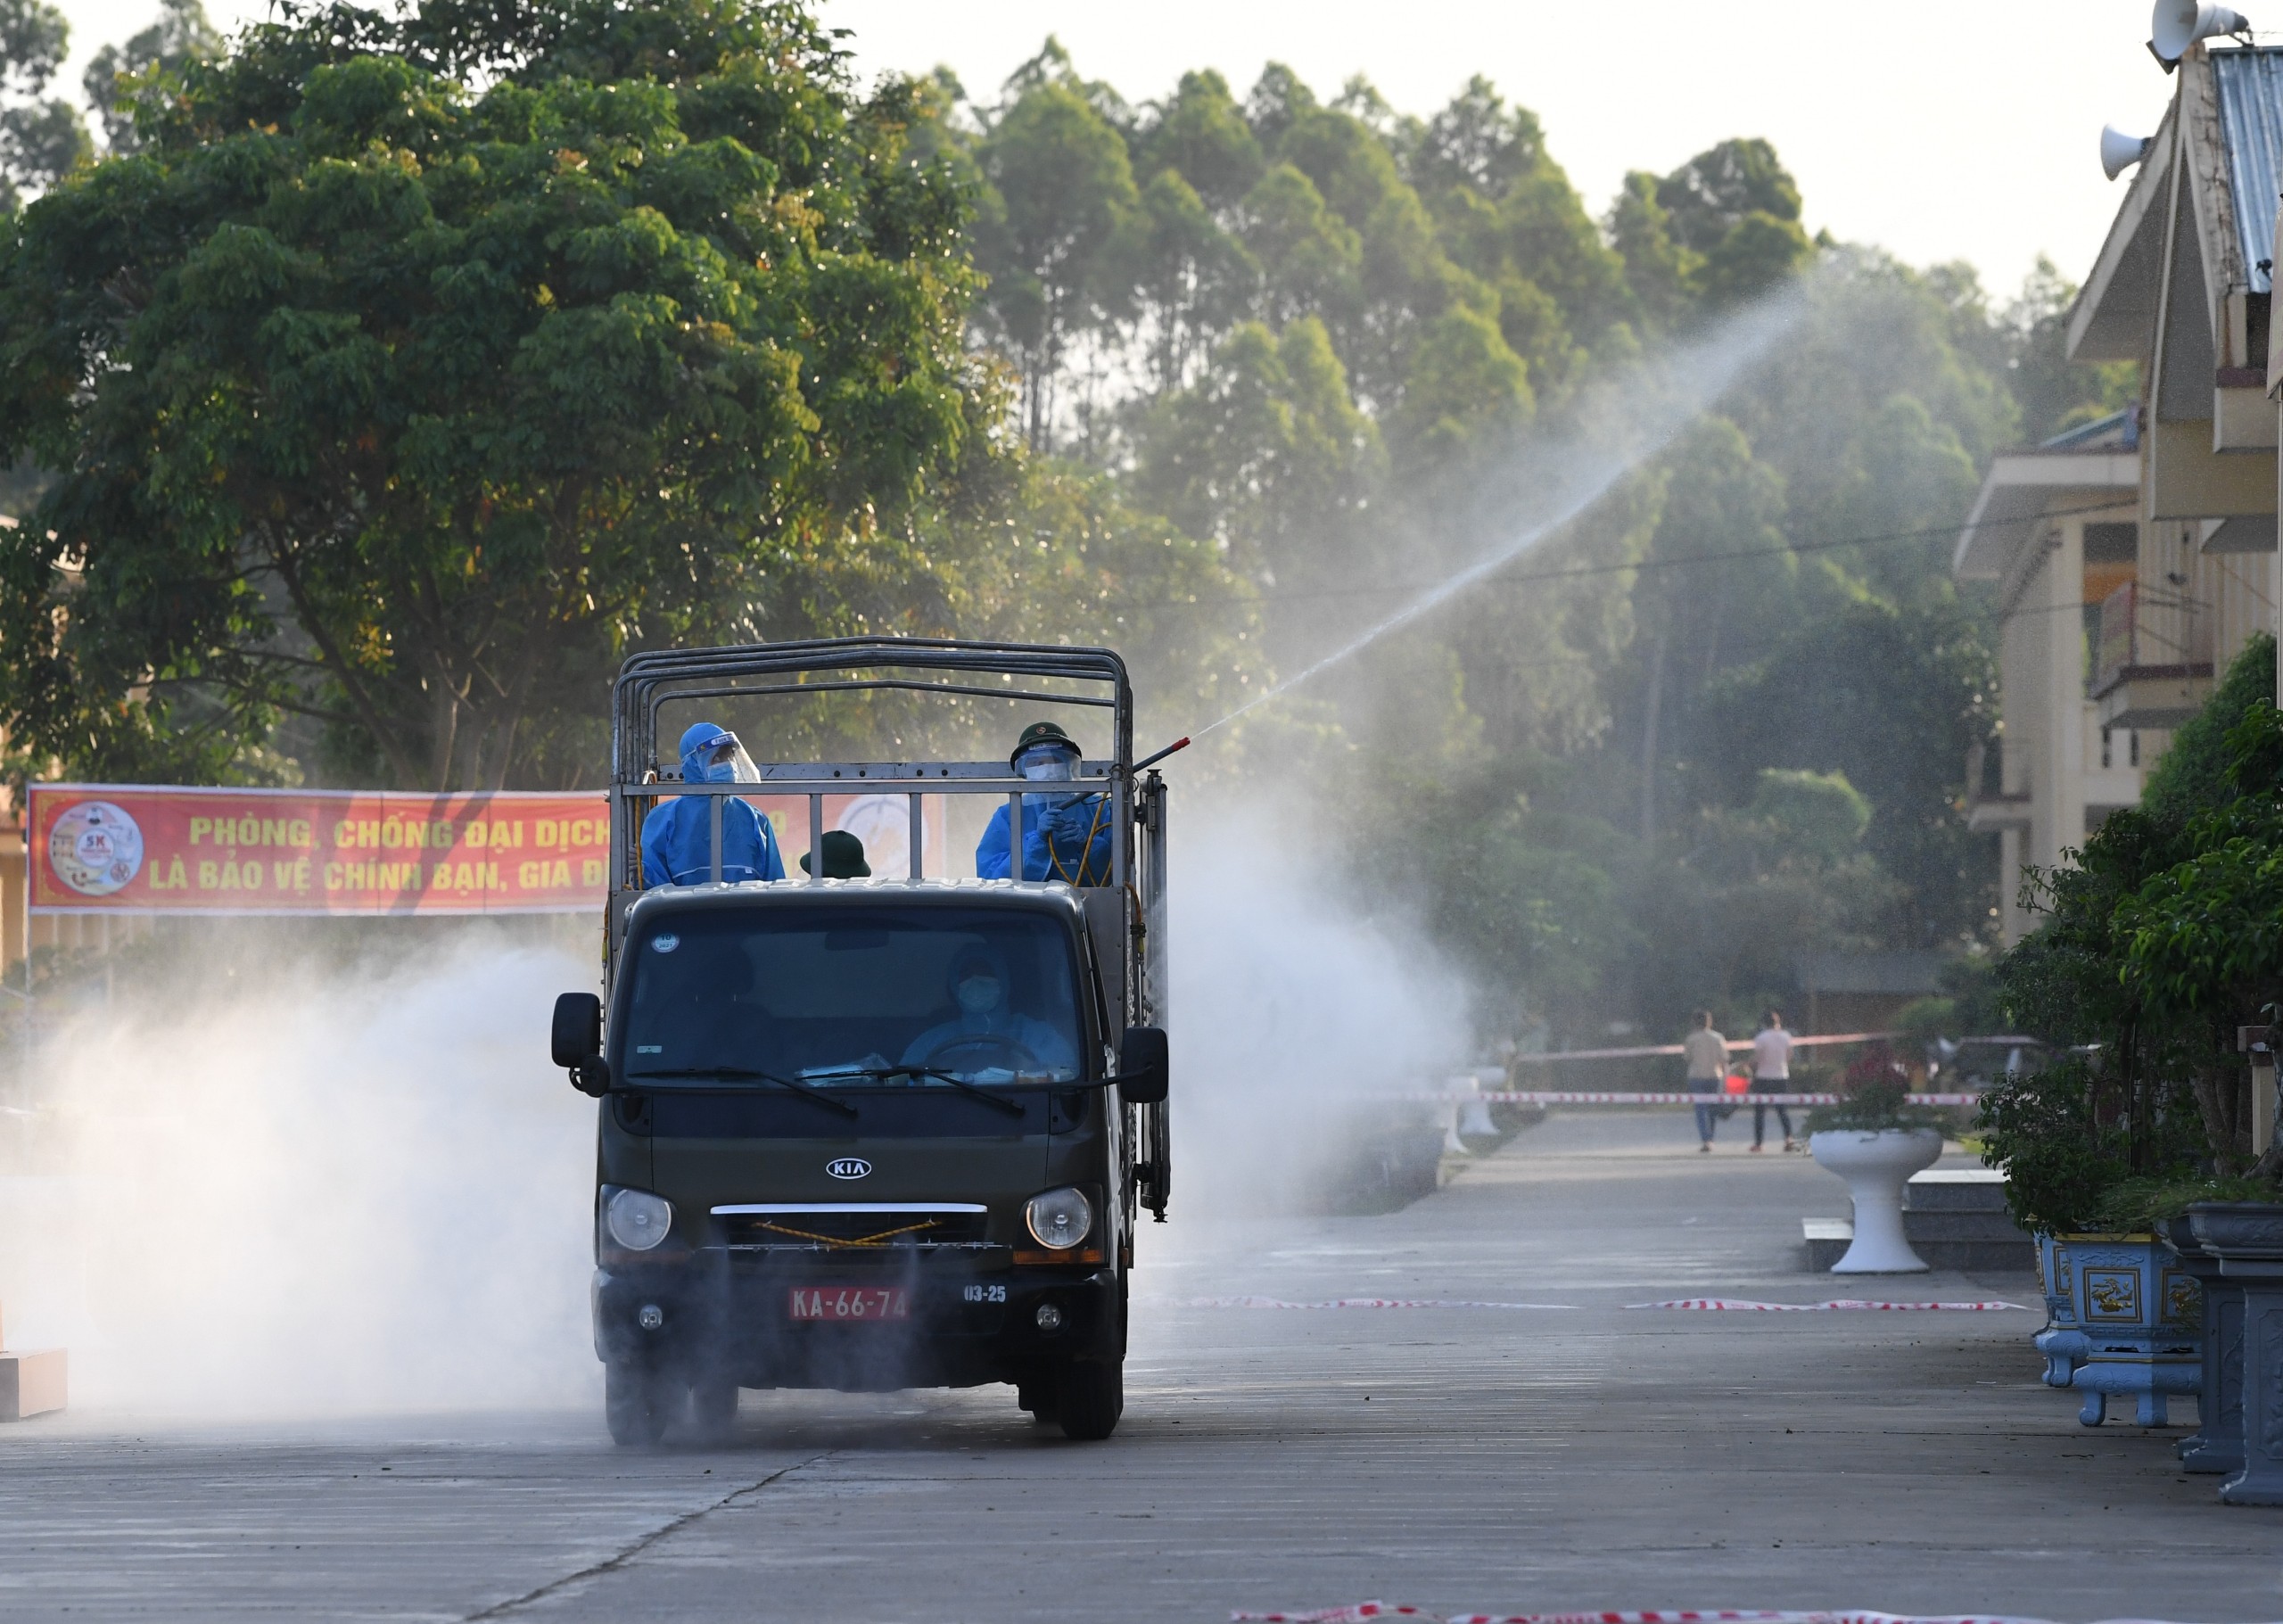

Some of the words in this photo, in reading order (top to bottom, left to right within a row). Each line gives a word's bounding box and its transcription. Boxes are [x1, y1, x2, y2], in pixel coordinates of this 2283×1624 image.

[189, 810, 321, 851] PHÒNG,
[334, 811, 453, 848] CHỐNG
[464, 820, 523, 854] ĐẠI
[149, 853, 189, 890] LÀ
[199, 848, 264, 890] BẢO
[274, 856, 311, 895] VỆ
[324, 856, 423, 891] CHÍNH
[432, 862, 507, 896] BẠN,
[519, 860, 573, 890] GIA
[834, 1162, 865, 1175] KIA
[793, 1290, 907, 1317] KA-66-74
[964, 1284, 1006, 1303] 03-25
